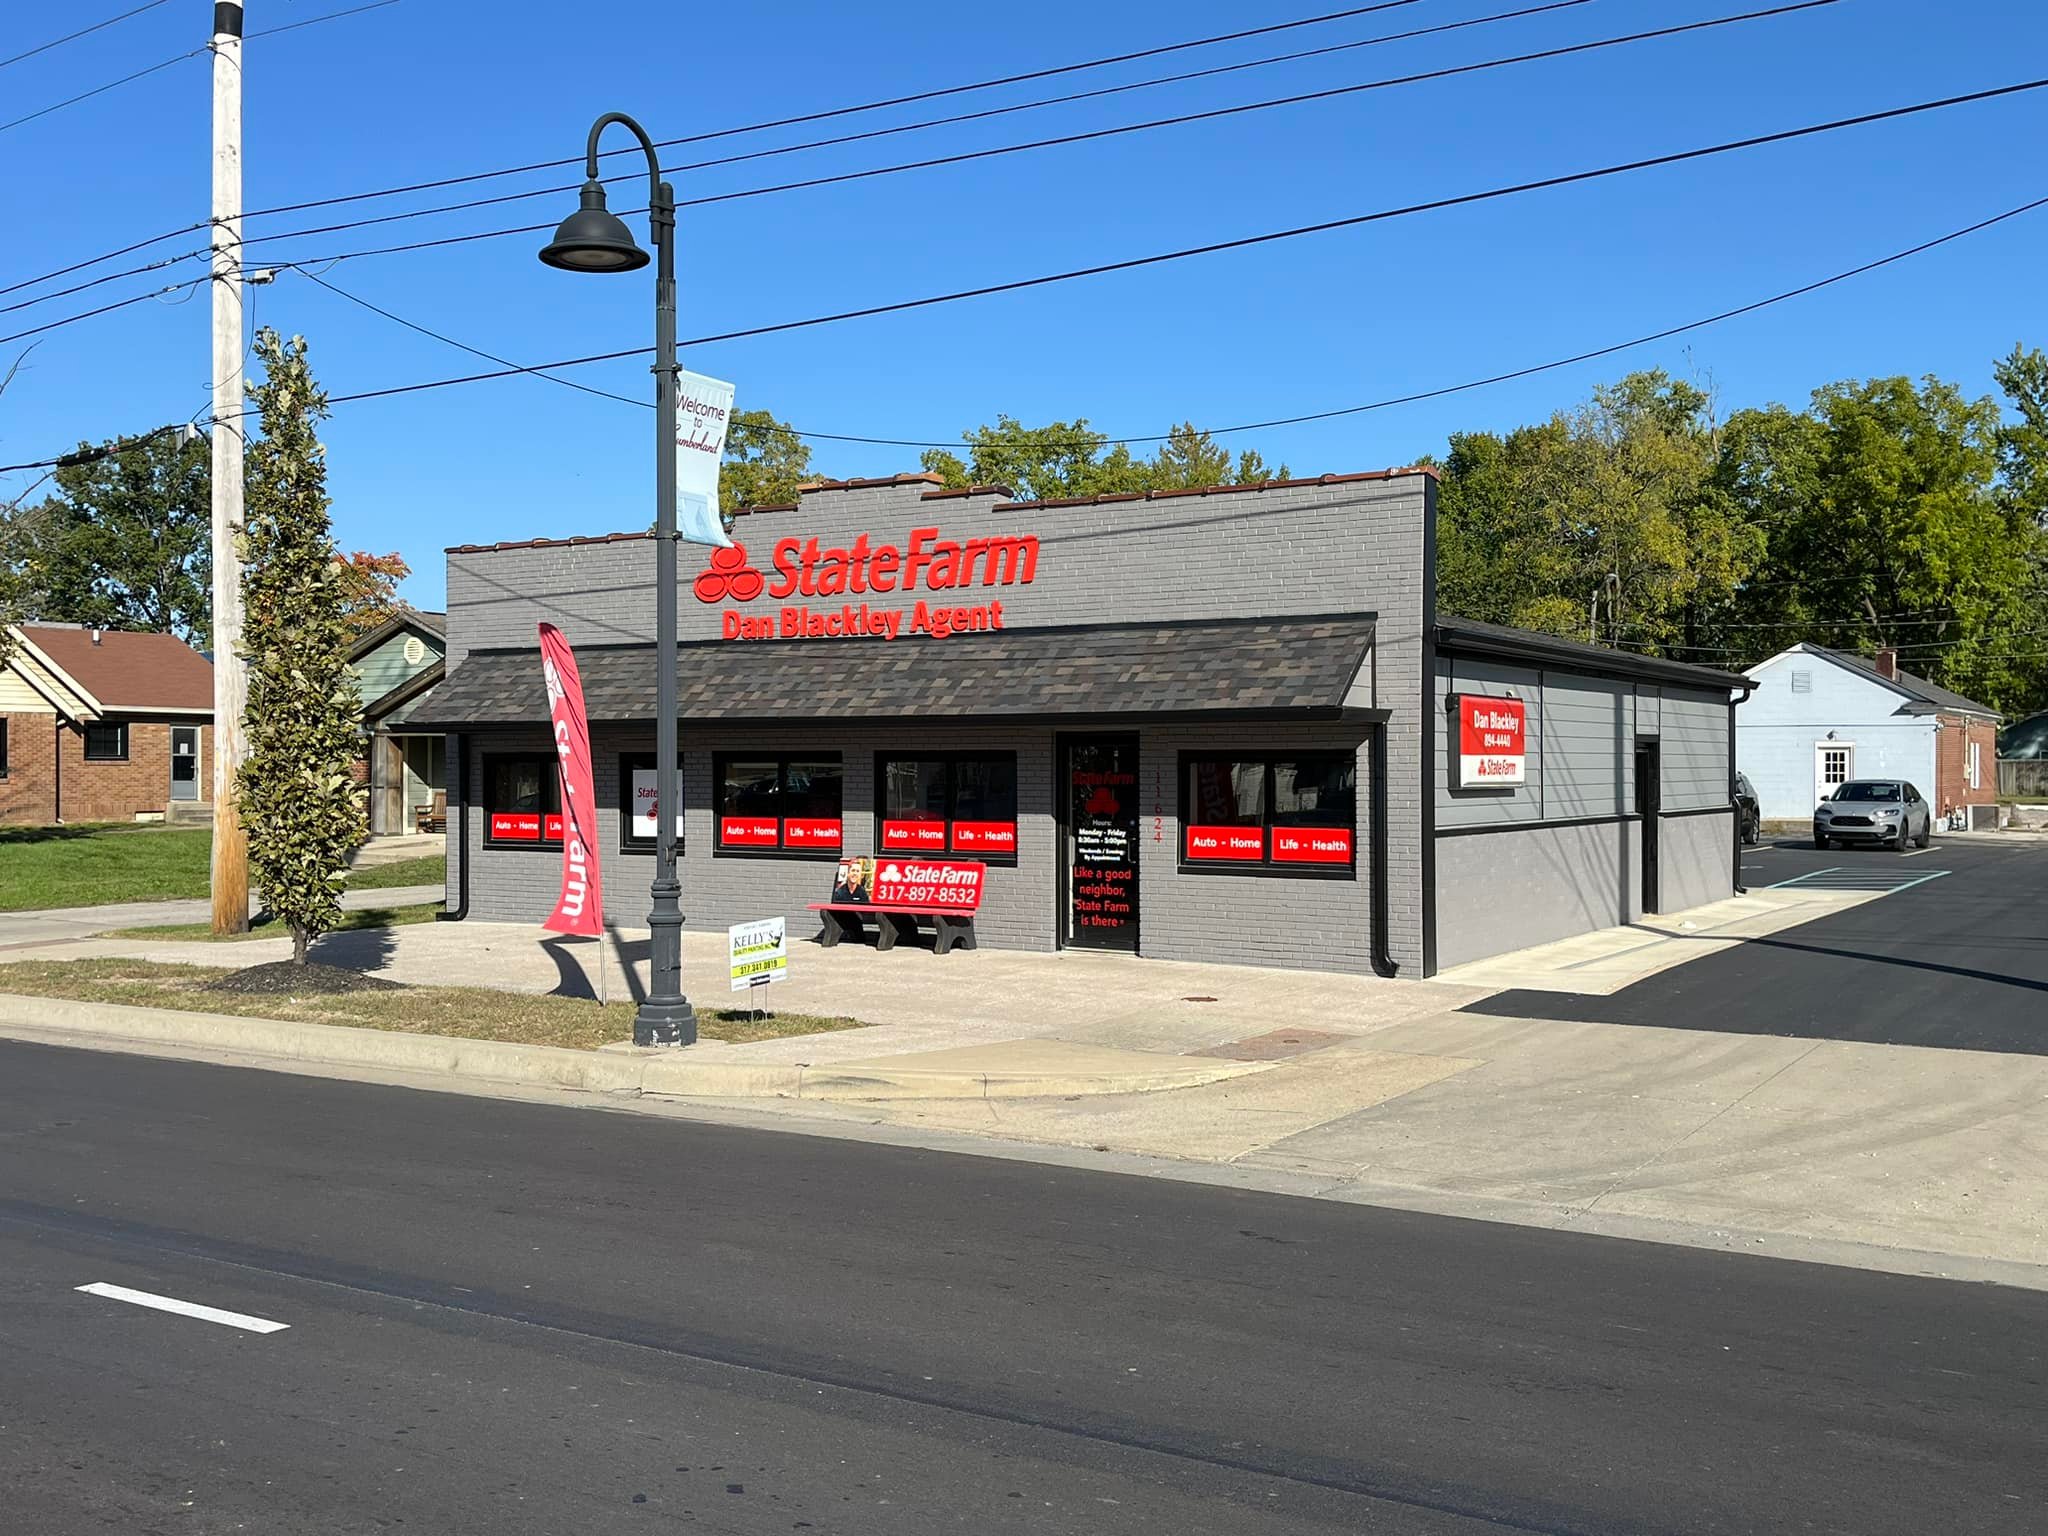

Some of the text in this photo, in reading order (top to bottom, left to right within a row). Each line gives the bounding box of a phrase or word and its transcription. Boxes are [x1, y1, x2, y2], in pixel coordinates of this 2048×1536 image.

[676, 393, 725, 421] Welcome
[693, 416, 703, 429] to
[676, 423, 722, 455] umberland
[722, 600, 1005, 641] Dan Blackley Agent
[1473, 709, 1519, 735] Dan Blackley
[495, 820, 512, 830] Auto
[519, 821, 538, 830] Home
[549, 821, 562, 830] Life
[726, 825, 745, 836] Auto
[753, 826, 777, 836] Home
[789, 828, 804, 837] Life
[813, 828, 839, 838] Health
[887, 828, 908, 839] Auto
[918, 829, 944, 840] Home
[958, 830, 975, 840] Life
[984, 831, 1013, 841] Health
[1078, 828, 1103, 837] Monday
[1107, 828, 1126, 838] Friday
[1192, 836, 1217, 848] Auto
[1230, 837, 1261, 849] Home
[1279, 838, 1299, 850] Life
[1312, 839, 1347, 851] Health
[1074, 866, 1132, 882] Like a good
[878, 885, 976, 903] 317-897-8532
[1079, 883, 1126, 898] neighbor,
[1076, 899, 1130, 913] State Farm
